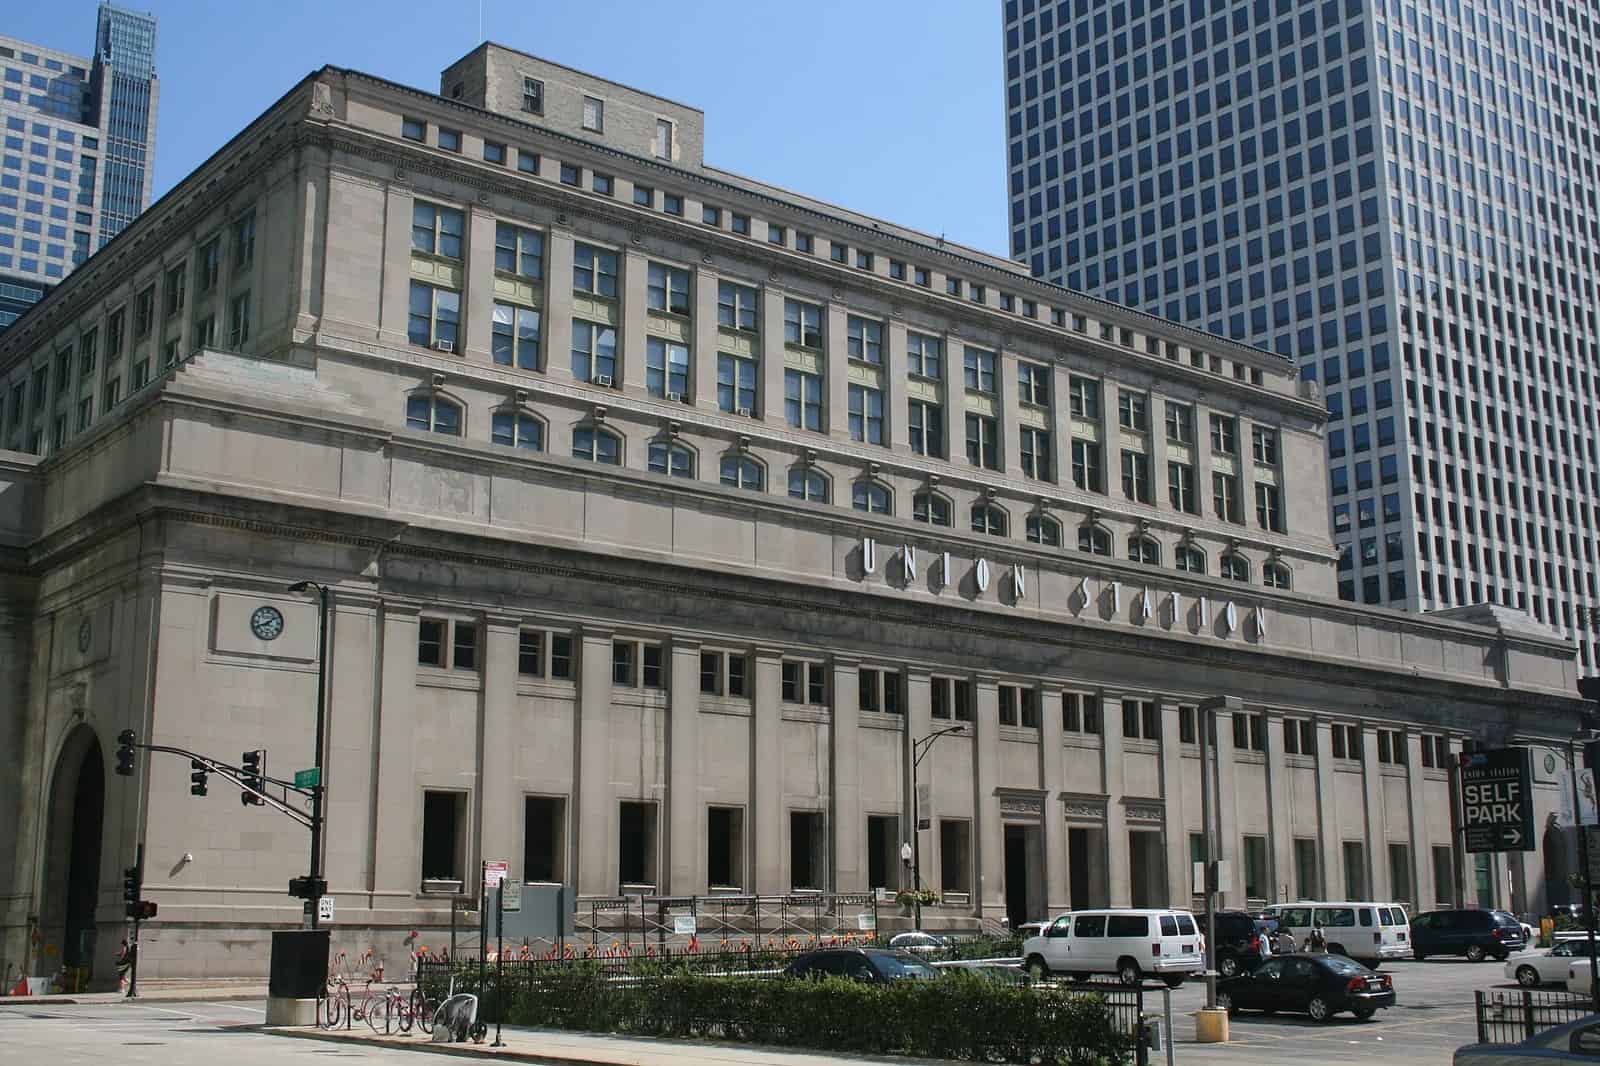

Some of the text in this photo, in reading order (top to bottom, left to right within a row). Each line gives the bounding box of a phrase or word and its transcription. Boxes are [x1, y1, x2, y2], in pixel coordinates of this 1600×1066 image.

[863, 537, 1265, 636] UNION STATION
[1465, 782, 1520, 805] SELF
[1466, 803, 1521, 825] PARK
